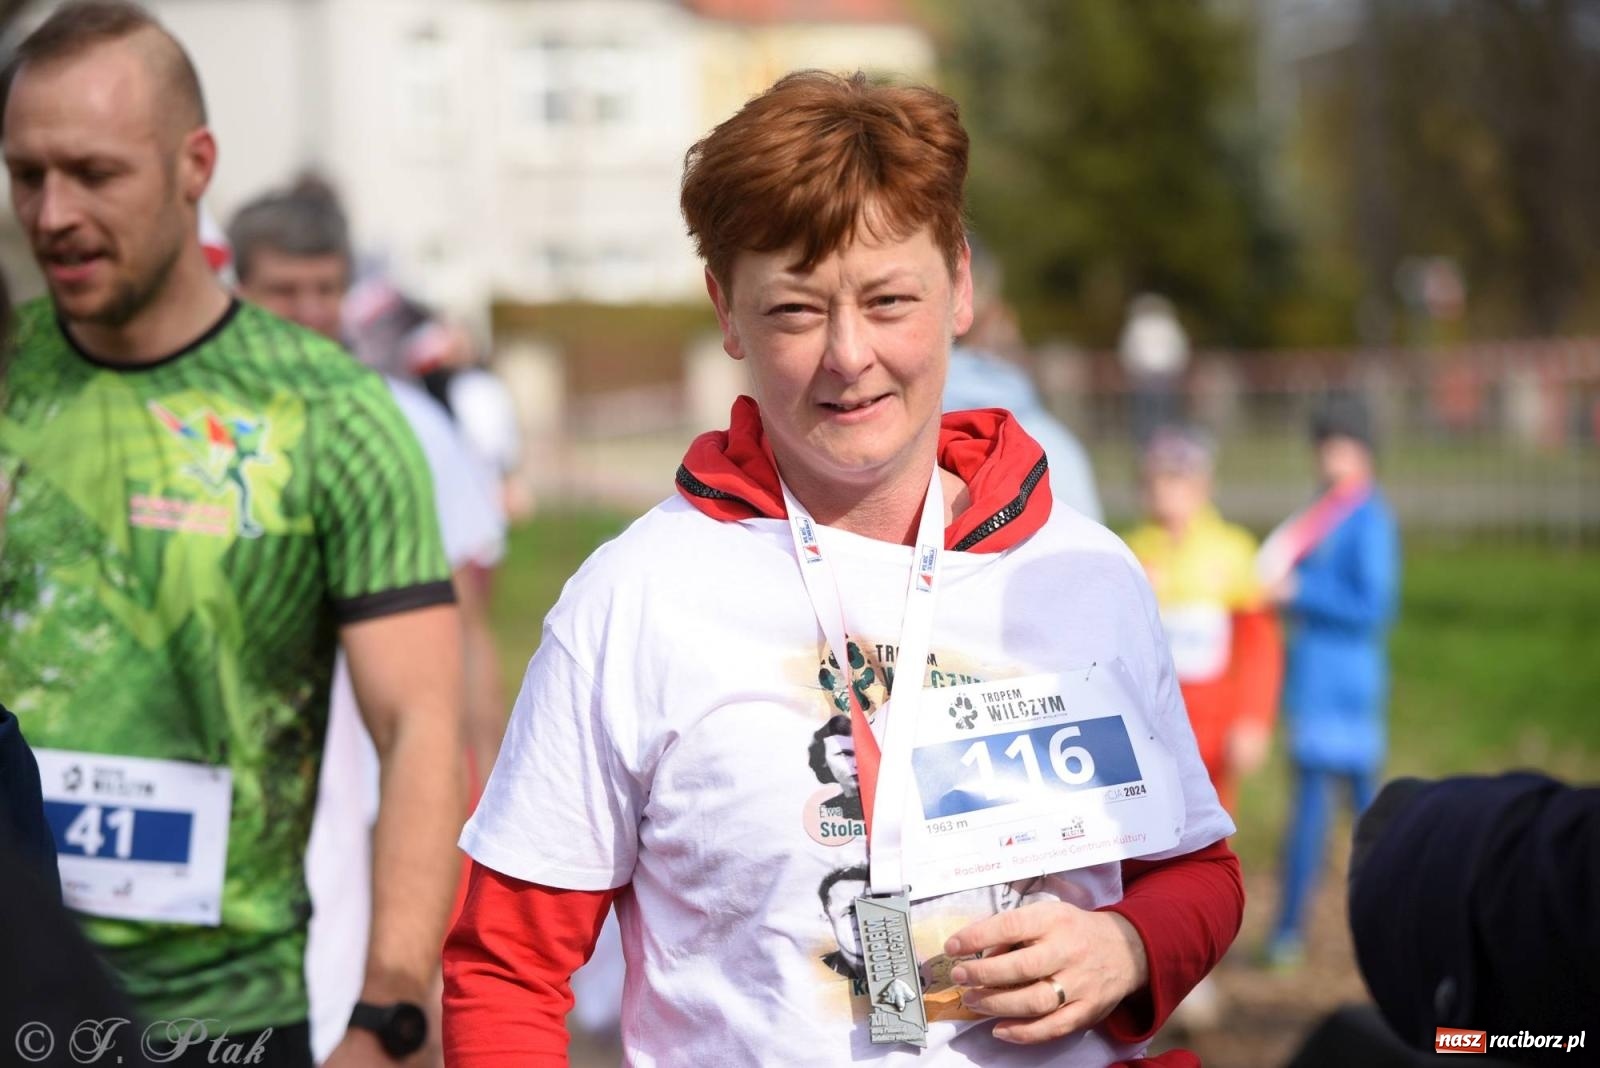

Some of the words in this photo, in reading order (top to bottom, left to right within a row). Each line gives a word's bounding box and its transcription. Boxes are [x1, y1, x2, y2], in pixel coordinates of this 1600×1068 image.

[981, 688, 1022, 703] TROPEM
[986, 695, 1066, 722] WILCZYM
[960, 726, 1095, 800] 116
[1123, 784, 1147, 798] 2024
[819, 804, 843, 818] Ewa
[65, 803, 136, 859] 41
[926, 820, 954, 834] 1963
[956, 819, 968, 830] m
[1069, 838, 1112, 854] Centrum
[1113, 832, 1147, 848] Kultury
[864, 917, 890, 982] TROPEM
[886, 914, 910, 977] WILCZYM
